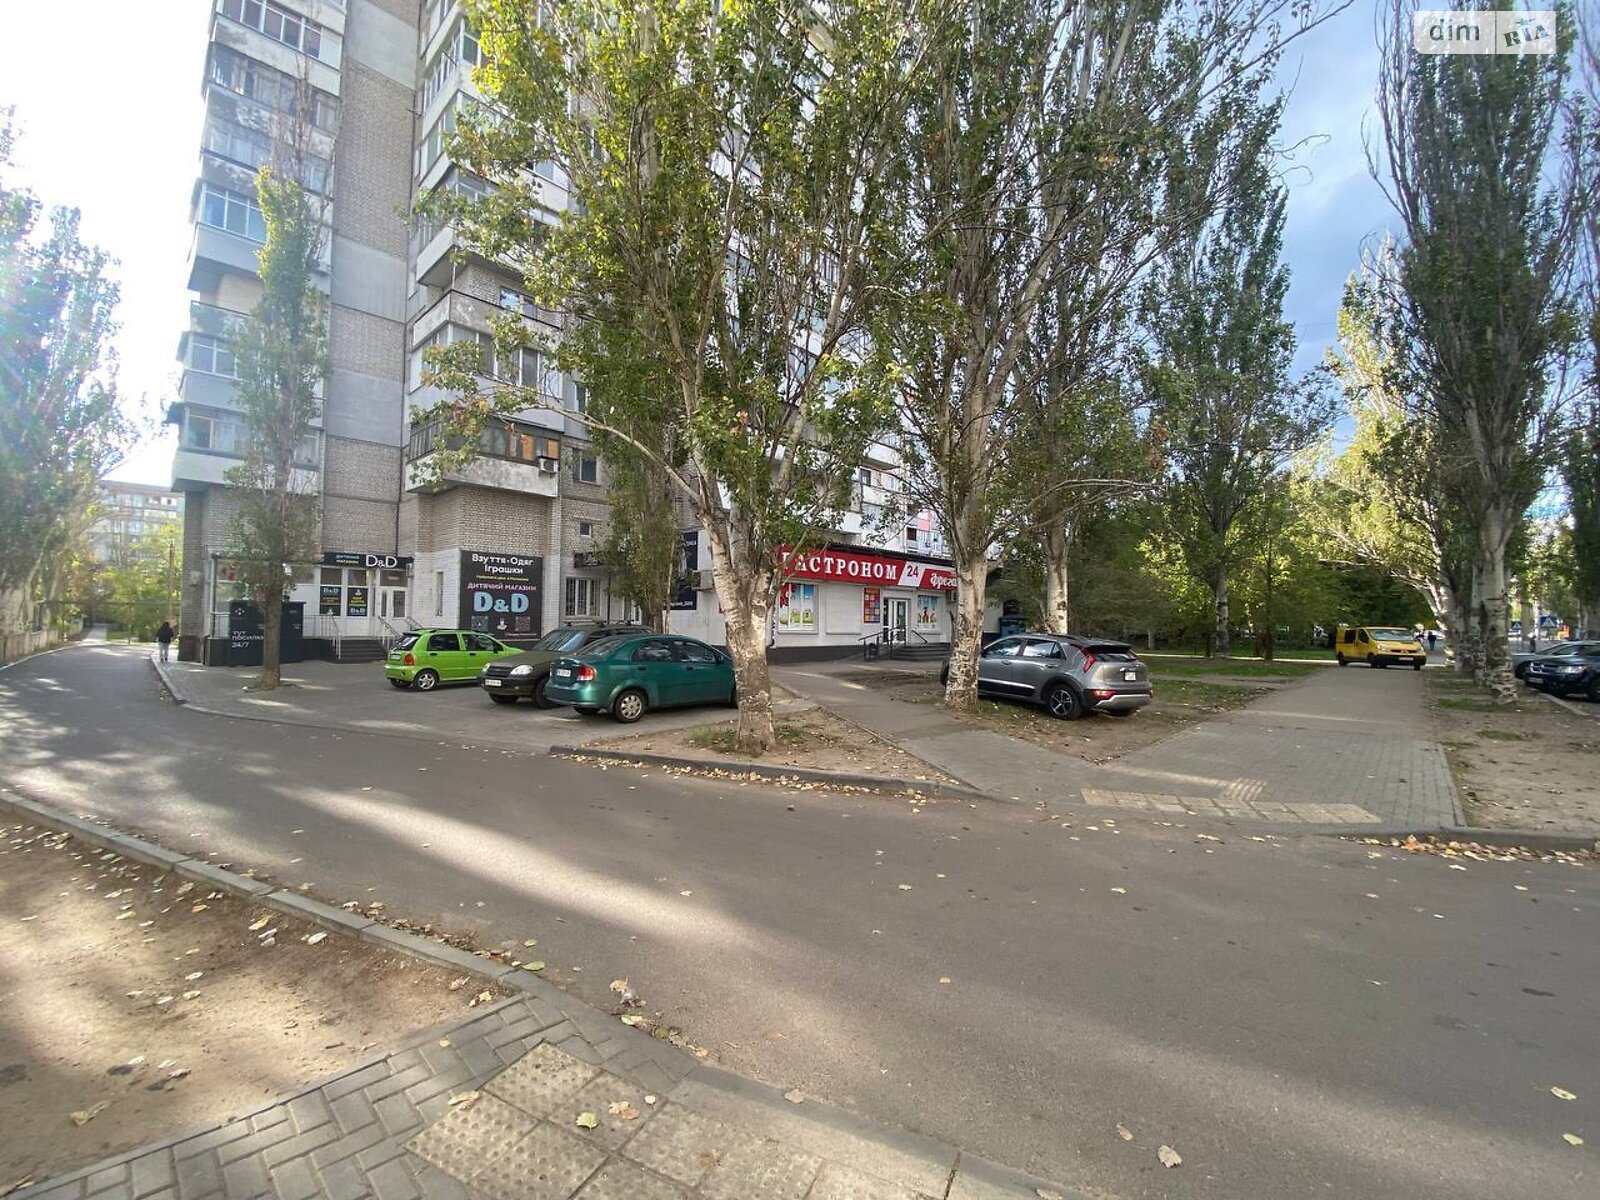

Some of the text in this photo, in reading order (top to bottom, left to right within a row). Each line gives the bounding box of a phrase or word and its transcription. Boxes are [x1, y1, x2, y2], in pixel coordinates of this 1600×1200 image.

[365, 554, 398, 568] D&D
[906, 564, 919, 578] 24
[473, 591, 530, 613] D&D
